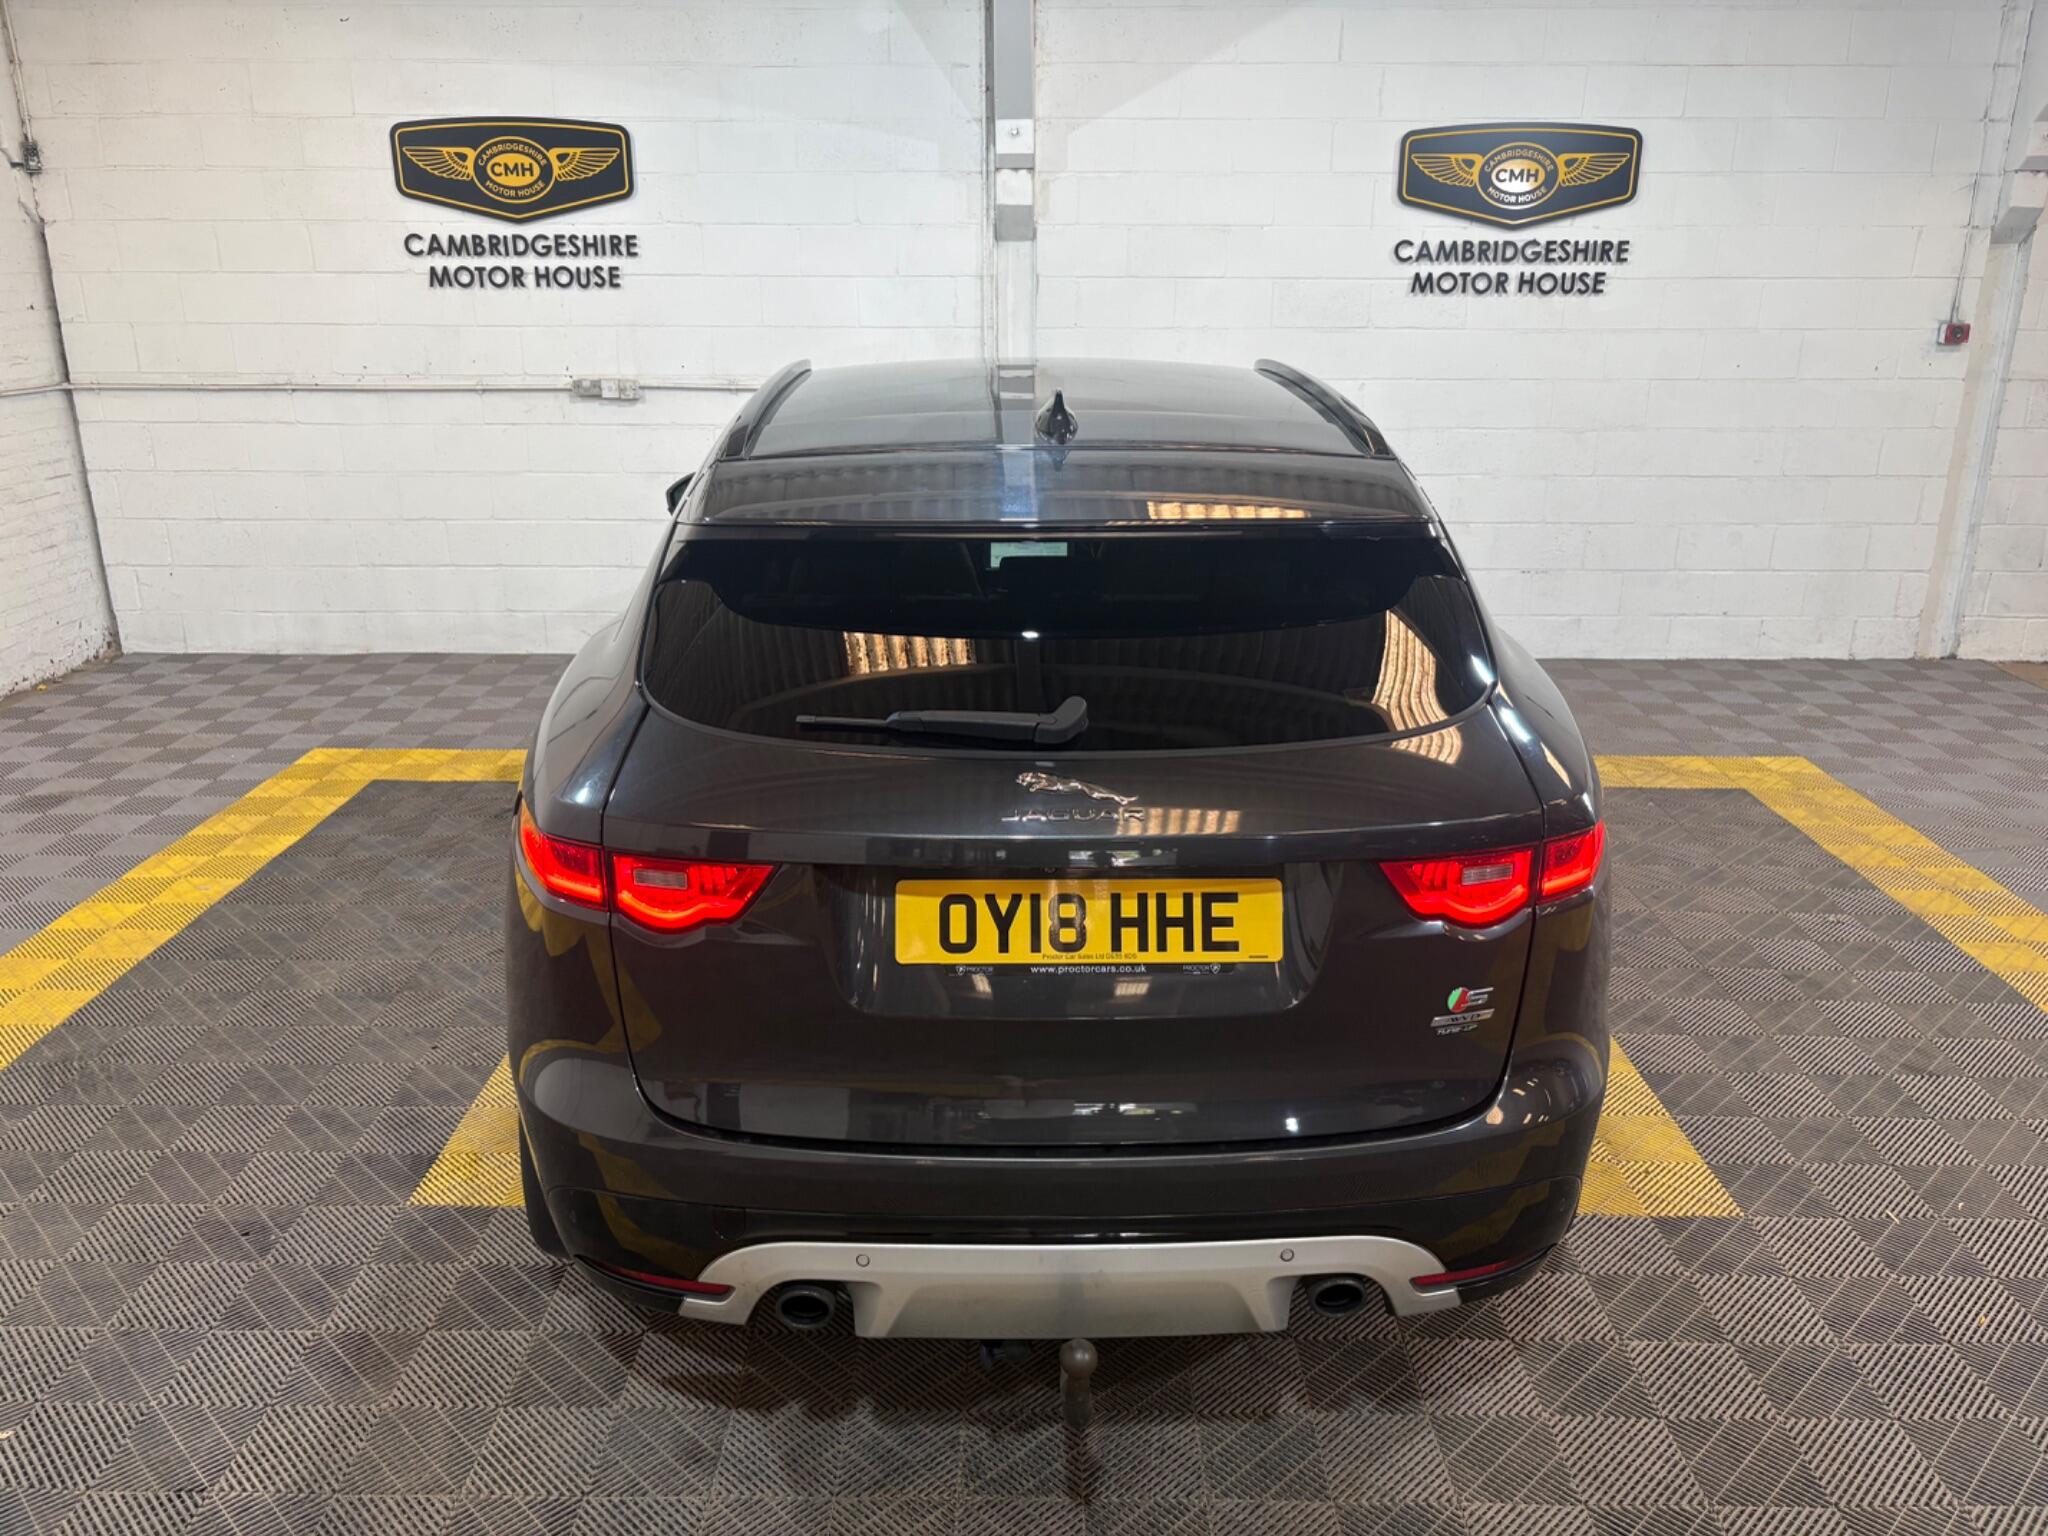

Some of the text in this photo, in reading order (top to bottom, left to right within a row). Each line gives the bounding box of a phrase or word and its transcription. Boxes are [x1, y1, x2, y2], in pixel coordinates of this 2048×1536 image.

[478, 143, 547, 166] CAMBRIDGESHIRE
[1484, 149, 1554, 172] CAMBRIDGESHIRE
[490, 162, 534, 177] CMH
[1495, 168, 1539, 183] CMH
[485, 180, 545, 197] MOTOR HOUSE
[1487, 186, 1549, 203] MOTOR HOUSE
[404, 233, 639, 258] CAMBRIDGESHIRE
[1394, 239, 1630, 264] CAMBRIDGESHIRE
[428, 265, 621, 288] MOTOR HOUSE
[1410, 271, 1607, 295] MOTOR HOUSE
[1001, 807, 1145, 822] JAGUAR
[938, 892, 1241, 954] OY18 HHE
[1030, 964, 1147, 974] www.proctorcars.co.uk
